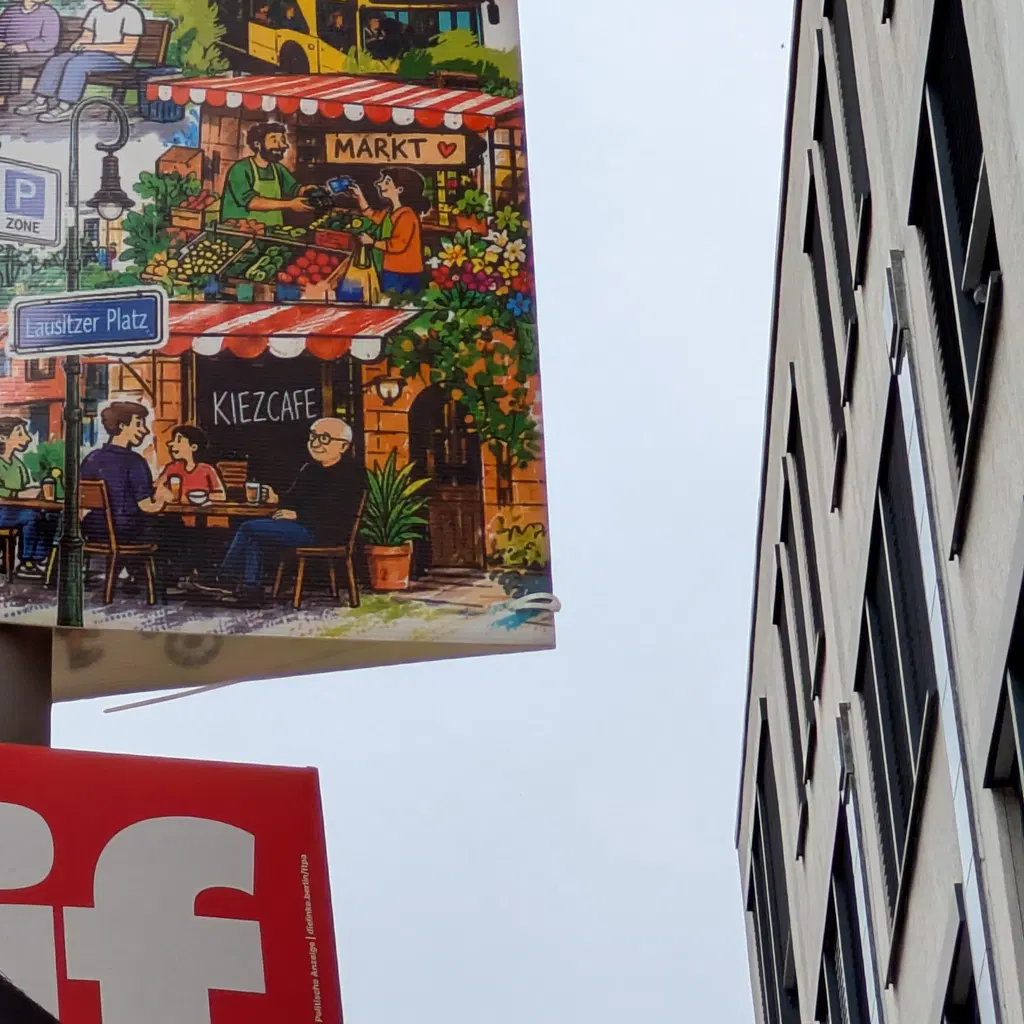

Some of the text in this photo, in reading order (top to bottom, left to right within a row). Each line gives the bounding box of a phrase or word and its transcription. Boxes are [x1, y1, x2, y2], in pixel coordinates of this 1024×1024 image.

[334, 137, 427, 161] MARKT
[15, 178, 37, 209] P
[6, 217, 40, 234] ZONE
[26, 307, 149, 337] Lausitzer Platz
[213, 388, 317, 425] KIEZCAFE
[308, 942, 319, 977] Anzeige
[312, 979, 324, 1023] Politische
